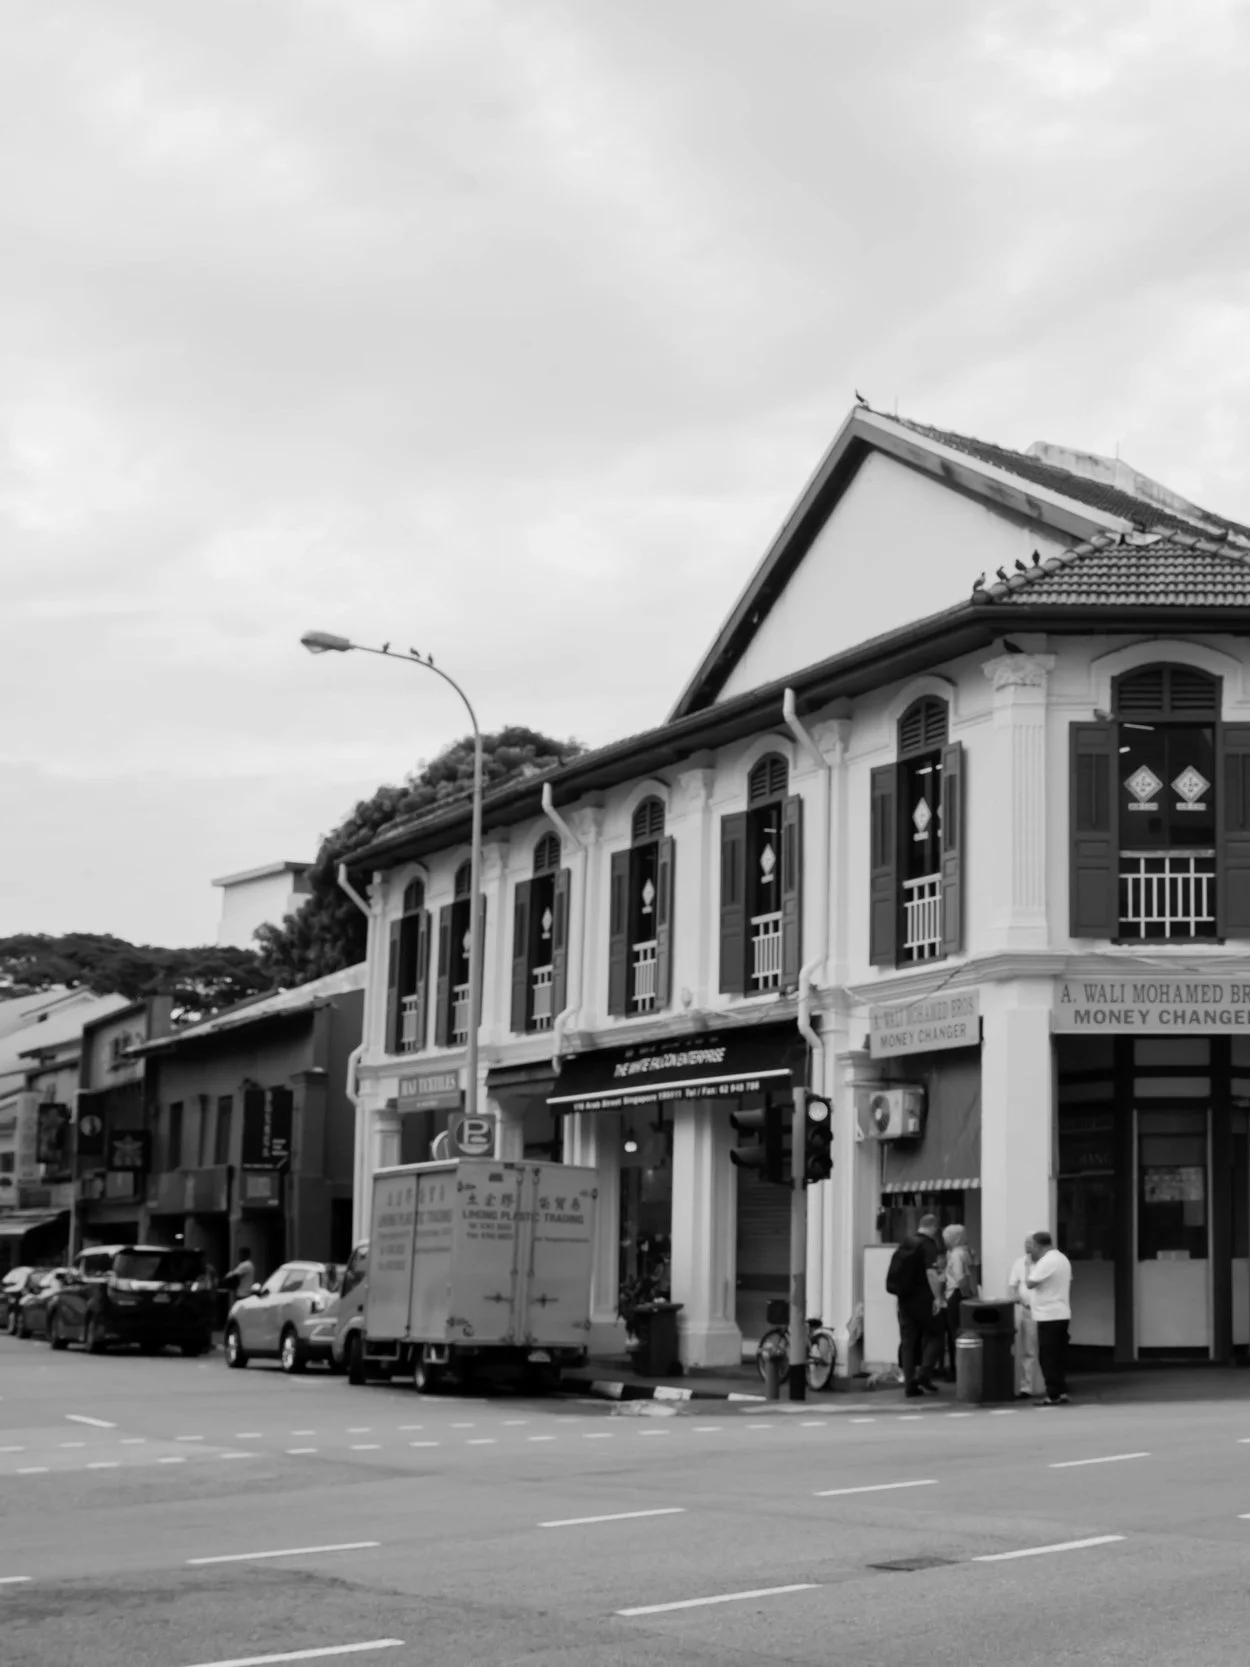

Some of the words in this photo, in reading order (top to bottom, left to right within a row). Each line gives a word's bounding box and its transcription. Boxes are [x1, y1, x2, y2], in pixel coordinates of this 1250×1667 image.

[1060, 983, 1077, 1004] A.
[1083, 983, 1126, 1004] WALI
[1132, 983, 1224, 1004] MOHAMED
[1073, 1009, 1150, 1025] MONEY
[881, 1031, 914, 1049] MONEY
[918, 1022, 967, 1044] CHANGER
[623, 1094, 657, 1106] Singapore
[544, 1212, 584, 1225] TRADING
